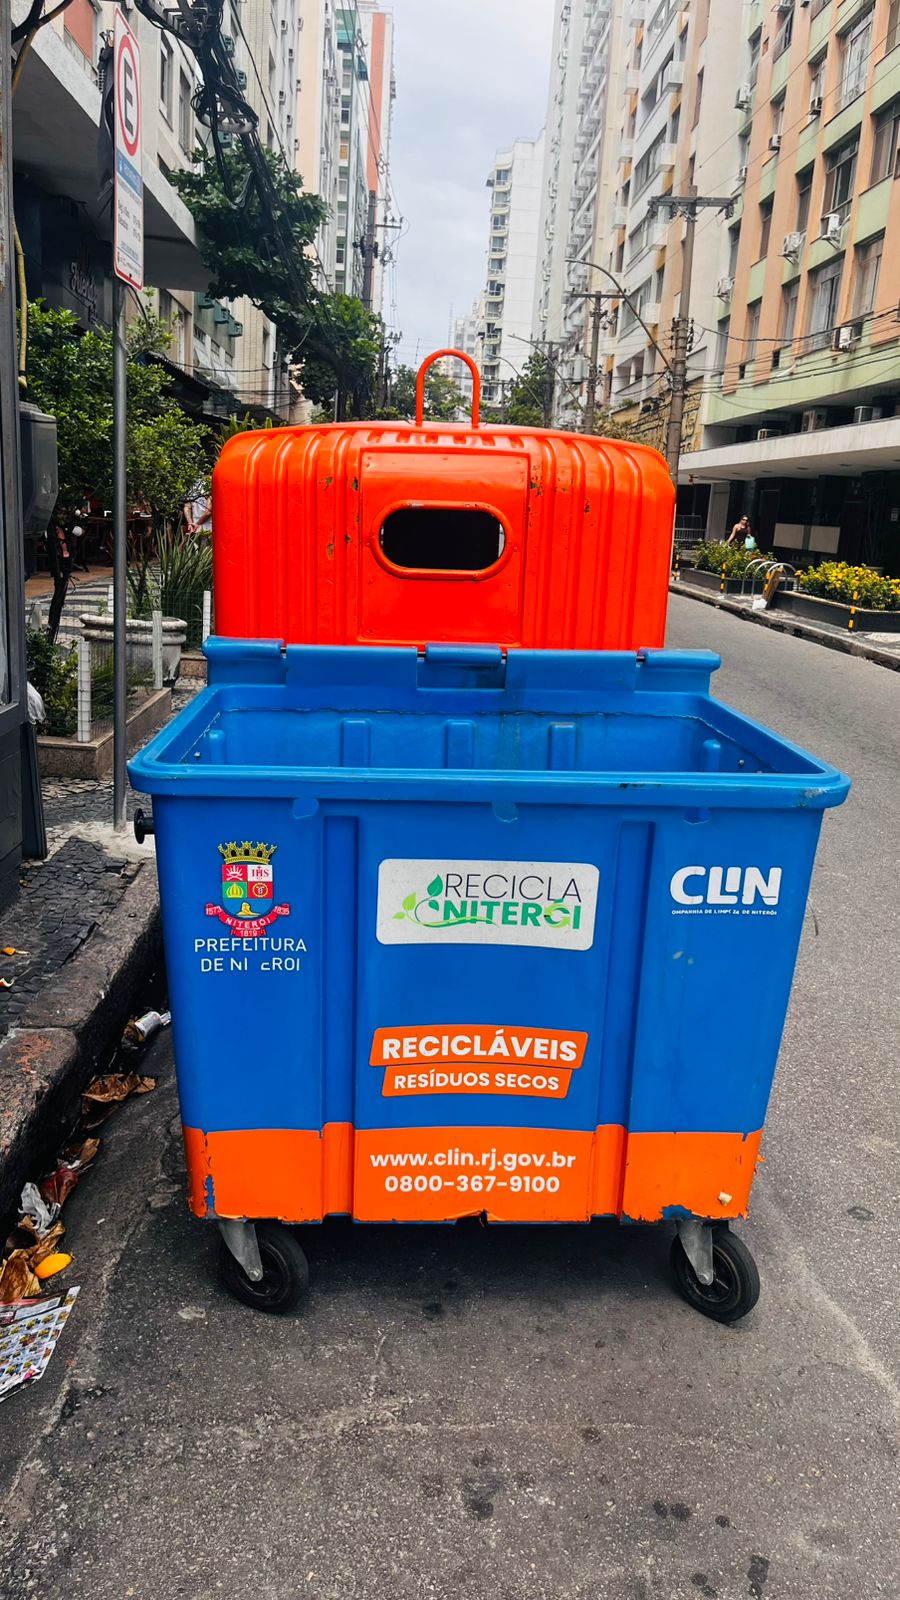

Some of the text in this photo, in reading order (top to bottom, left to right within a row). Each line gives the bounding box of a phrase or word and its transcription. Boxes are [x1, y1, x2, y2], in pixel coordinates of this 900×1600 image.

[124, 57, 134, 138] E
[251, 869, 270, 878] IHS
[444, 873, 582, 903] RECICLA
[670, 866, 782, 905] CLIN
[194, 938, 307, 952] PREFEITURA
[201, 958, 224, 972] DE
[382, 1029, 577, 1062] RECICLÁVEIS
[394, 1069, 560, 1091] RESÍDUOS SECOS
[370, 1148, 576, 1172] www.clin.rj.gov.br
[384, 1175, 560, 1193] 0800-367-9100
